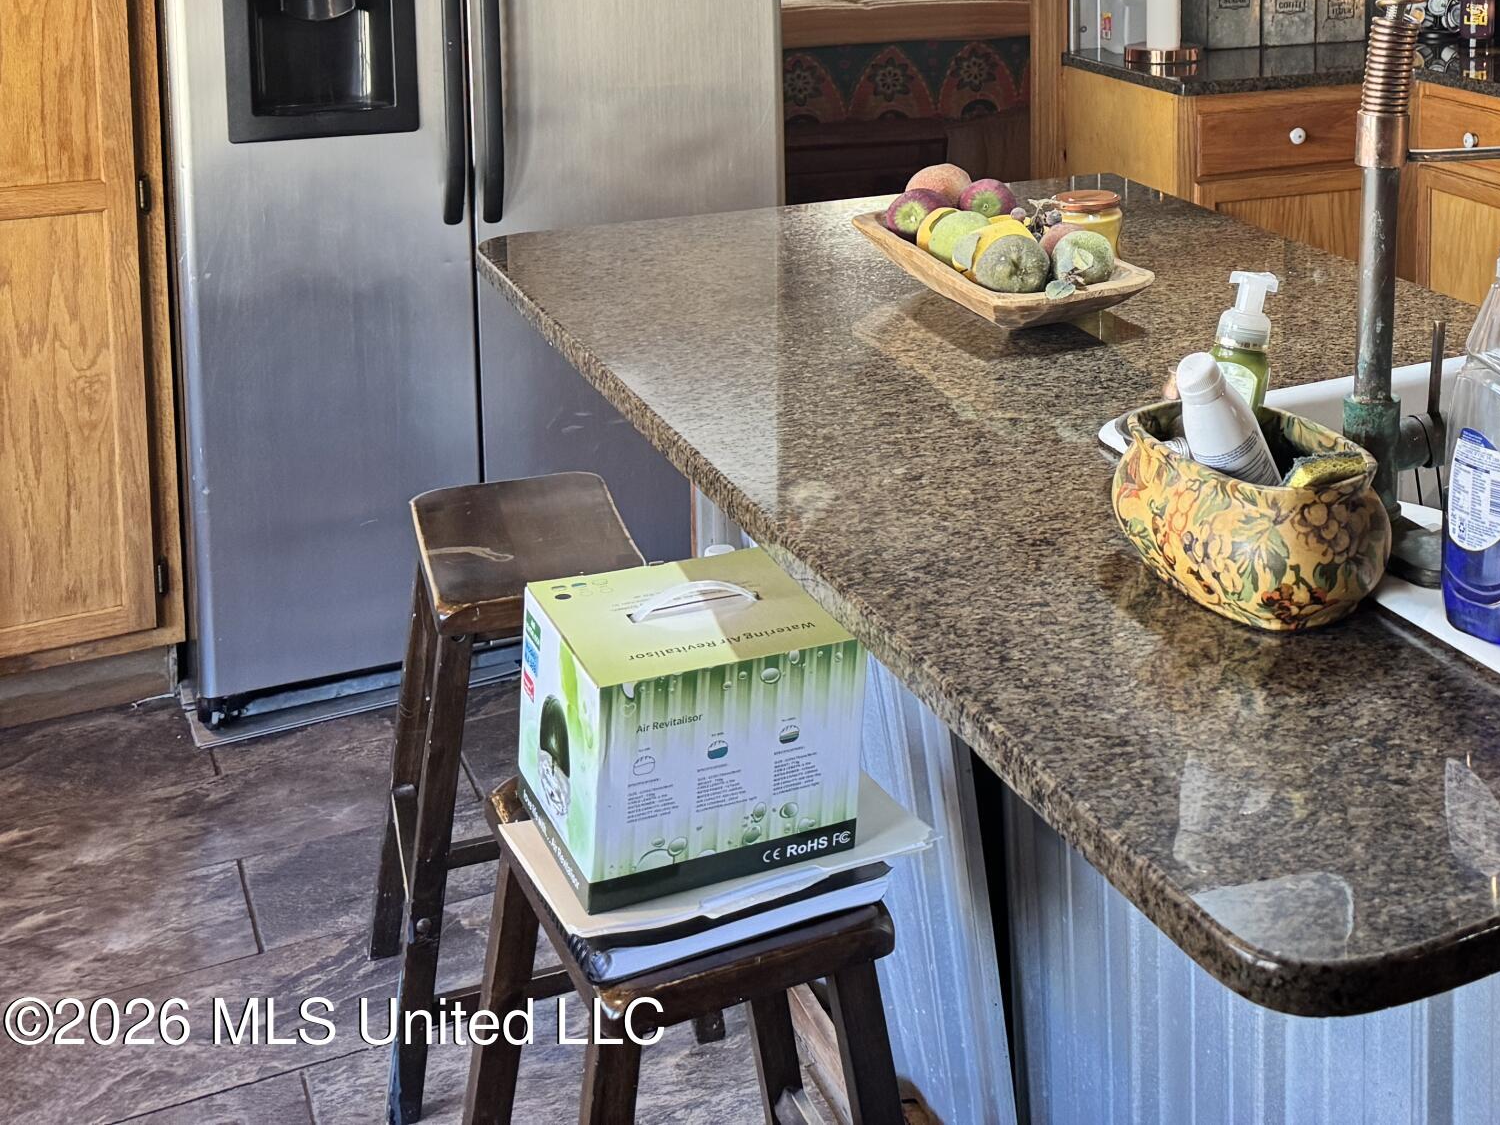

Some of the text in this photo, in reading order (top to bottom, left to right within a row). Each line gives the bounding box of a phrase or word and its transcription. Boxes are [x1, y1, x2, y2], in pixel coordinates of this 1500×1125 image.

[627, 621, 816, 662] Watering Air Revitalisor
[635, 713, 704, 735] Air Revitalisor
[786, 836, 828, 858] RoHS
